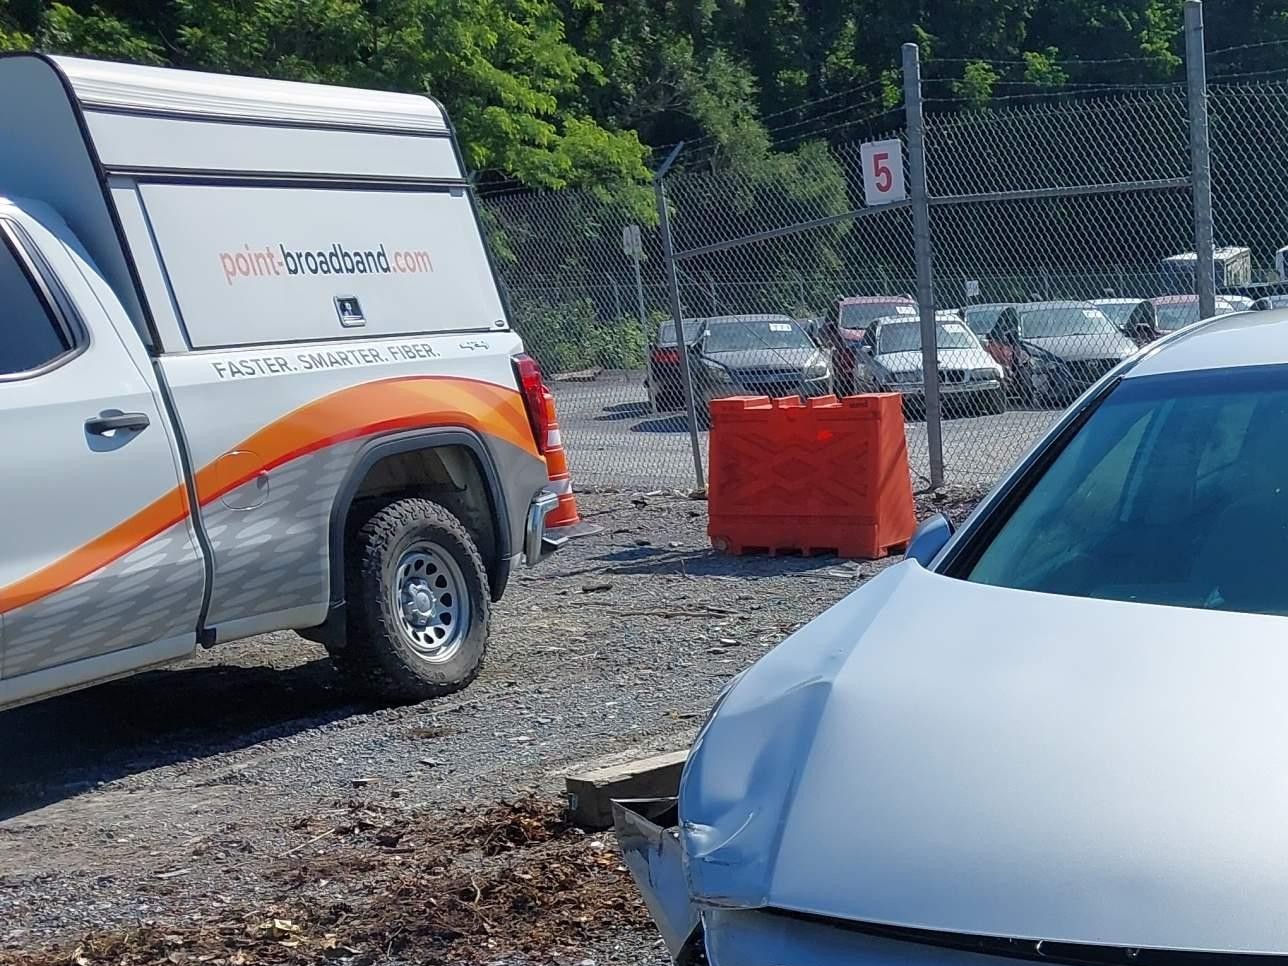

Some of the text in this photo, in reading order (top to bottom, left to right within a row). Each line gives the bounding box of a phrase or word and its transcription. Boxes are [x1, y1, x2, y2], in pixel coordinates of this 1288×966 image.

[873, 152, 892, 192] 5
[219, 243, 434, 285] point-broadband.com
[212, 342, 441, 379] FASTER. SMARTER. FIBER.
